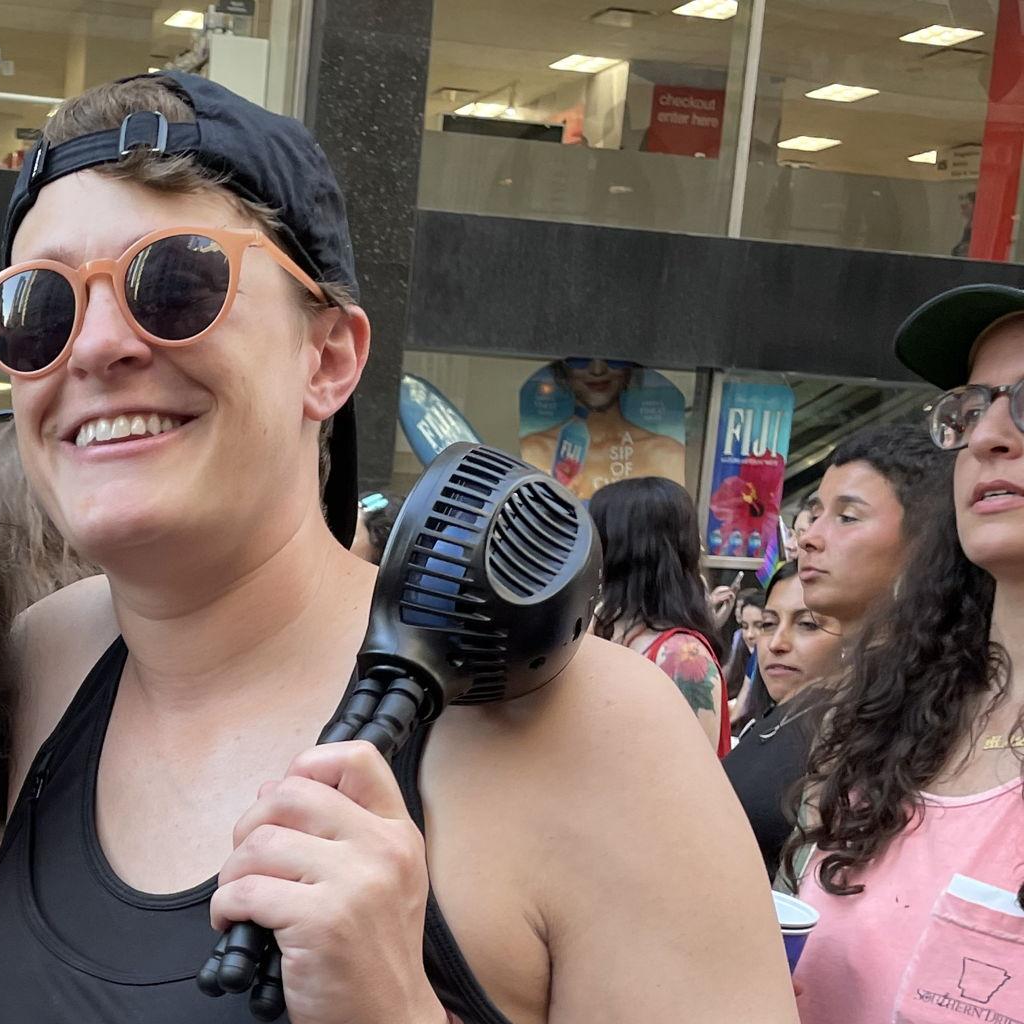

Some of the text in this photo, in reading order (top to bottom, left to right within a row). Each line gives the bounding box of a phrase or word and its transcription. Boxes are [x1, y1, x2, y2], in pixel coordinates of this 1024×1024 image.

[658, 94, 716, 111] checkout
[657, 111, 720, 128] enter here
[621, 431, 634, 445] A
[723, 408, 782, 458] FIJI
[560, 439, 582, 461] FIJI
[609, 446, 634, 461] SIP
[610, 461, 633, 476] OF
